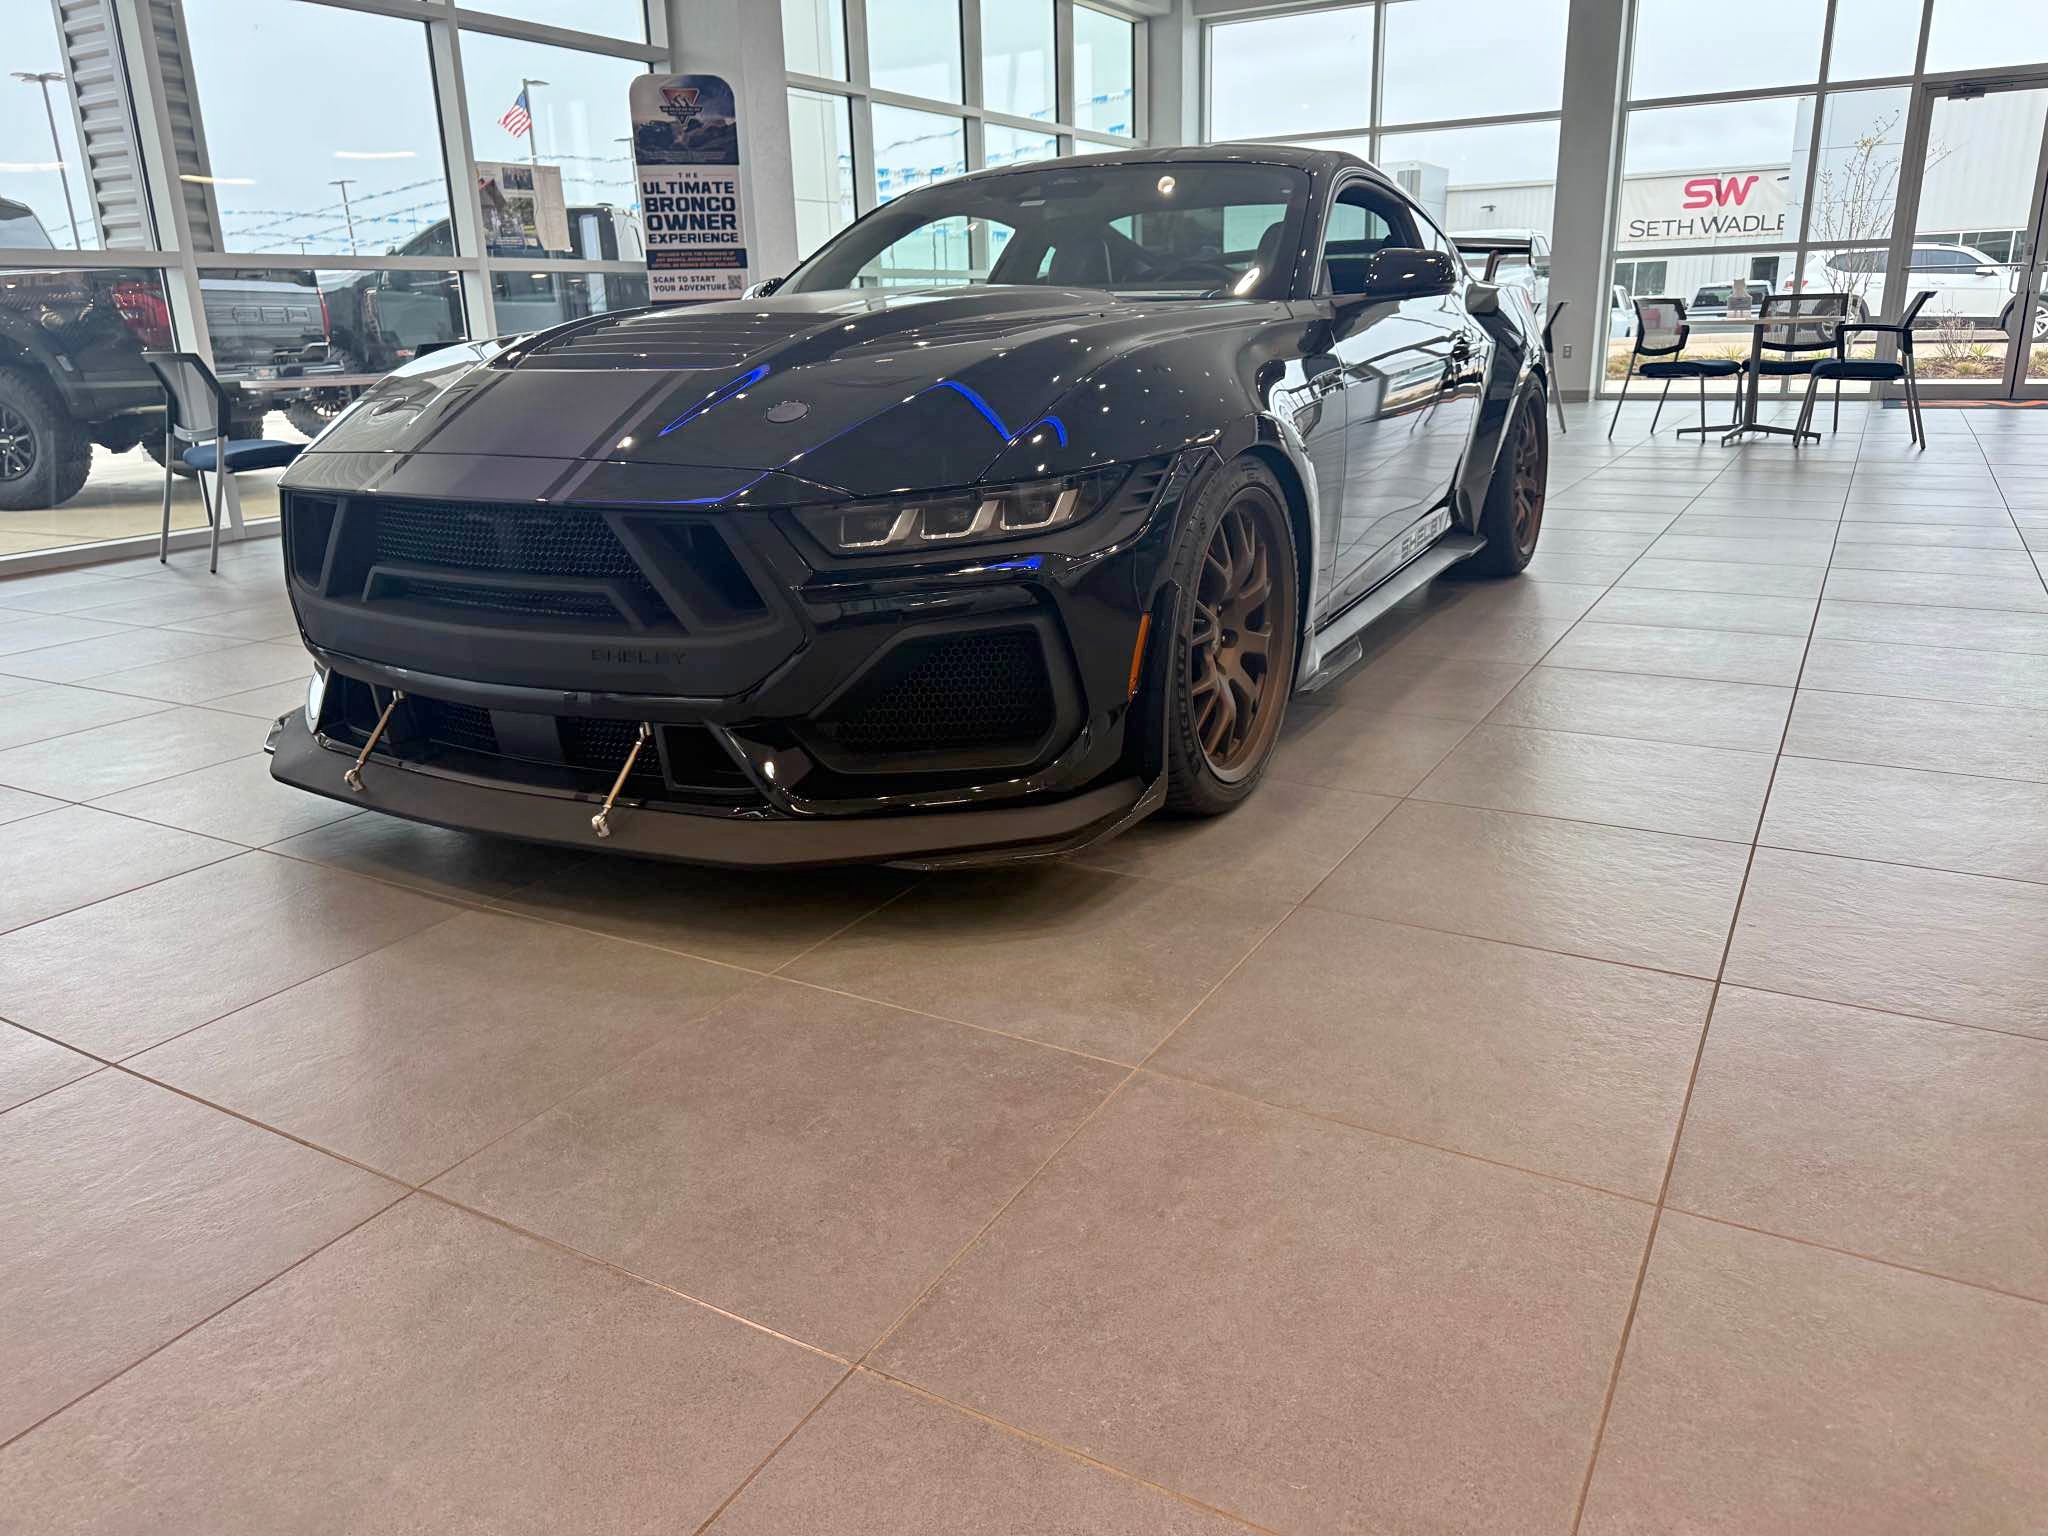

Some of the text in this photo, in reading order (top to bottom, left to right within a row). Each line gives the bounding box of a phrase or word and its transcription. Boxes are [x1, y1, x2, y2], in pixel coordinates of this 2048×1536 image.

[643, 181, 734, 194] ULTIMATE
[1683, 175, 1760, 209] SW
[645, 196, 736, 212] BRONCO
[647, 214, 737, 231] OWNER
[1629, 218, 1694, 238] SETH
[648, 232, 739, 243] EXPERIENCE
[690, 275, 716, 283] START
[654, 283, 727, 292] YOUR ADVENTURE
[591, 649, 688, 666] SHELBY
